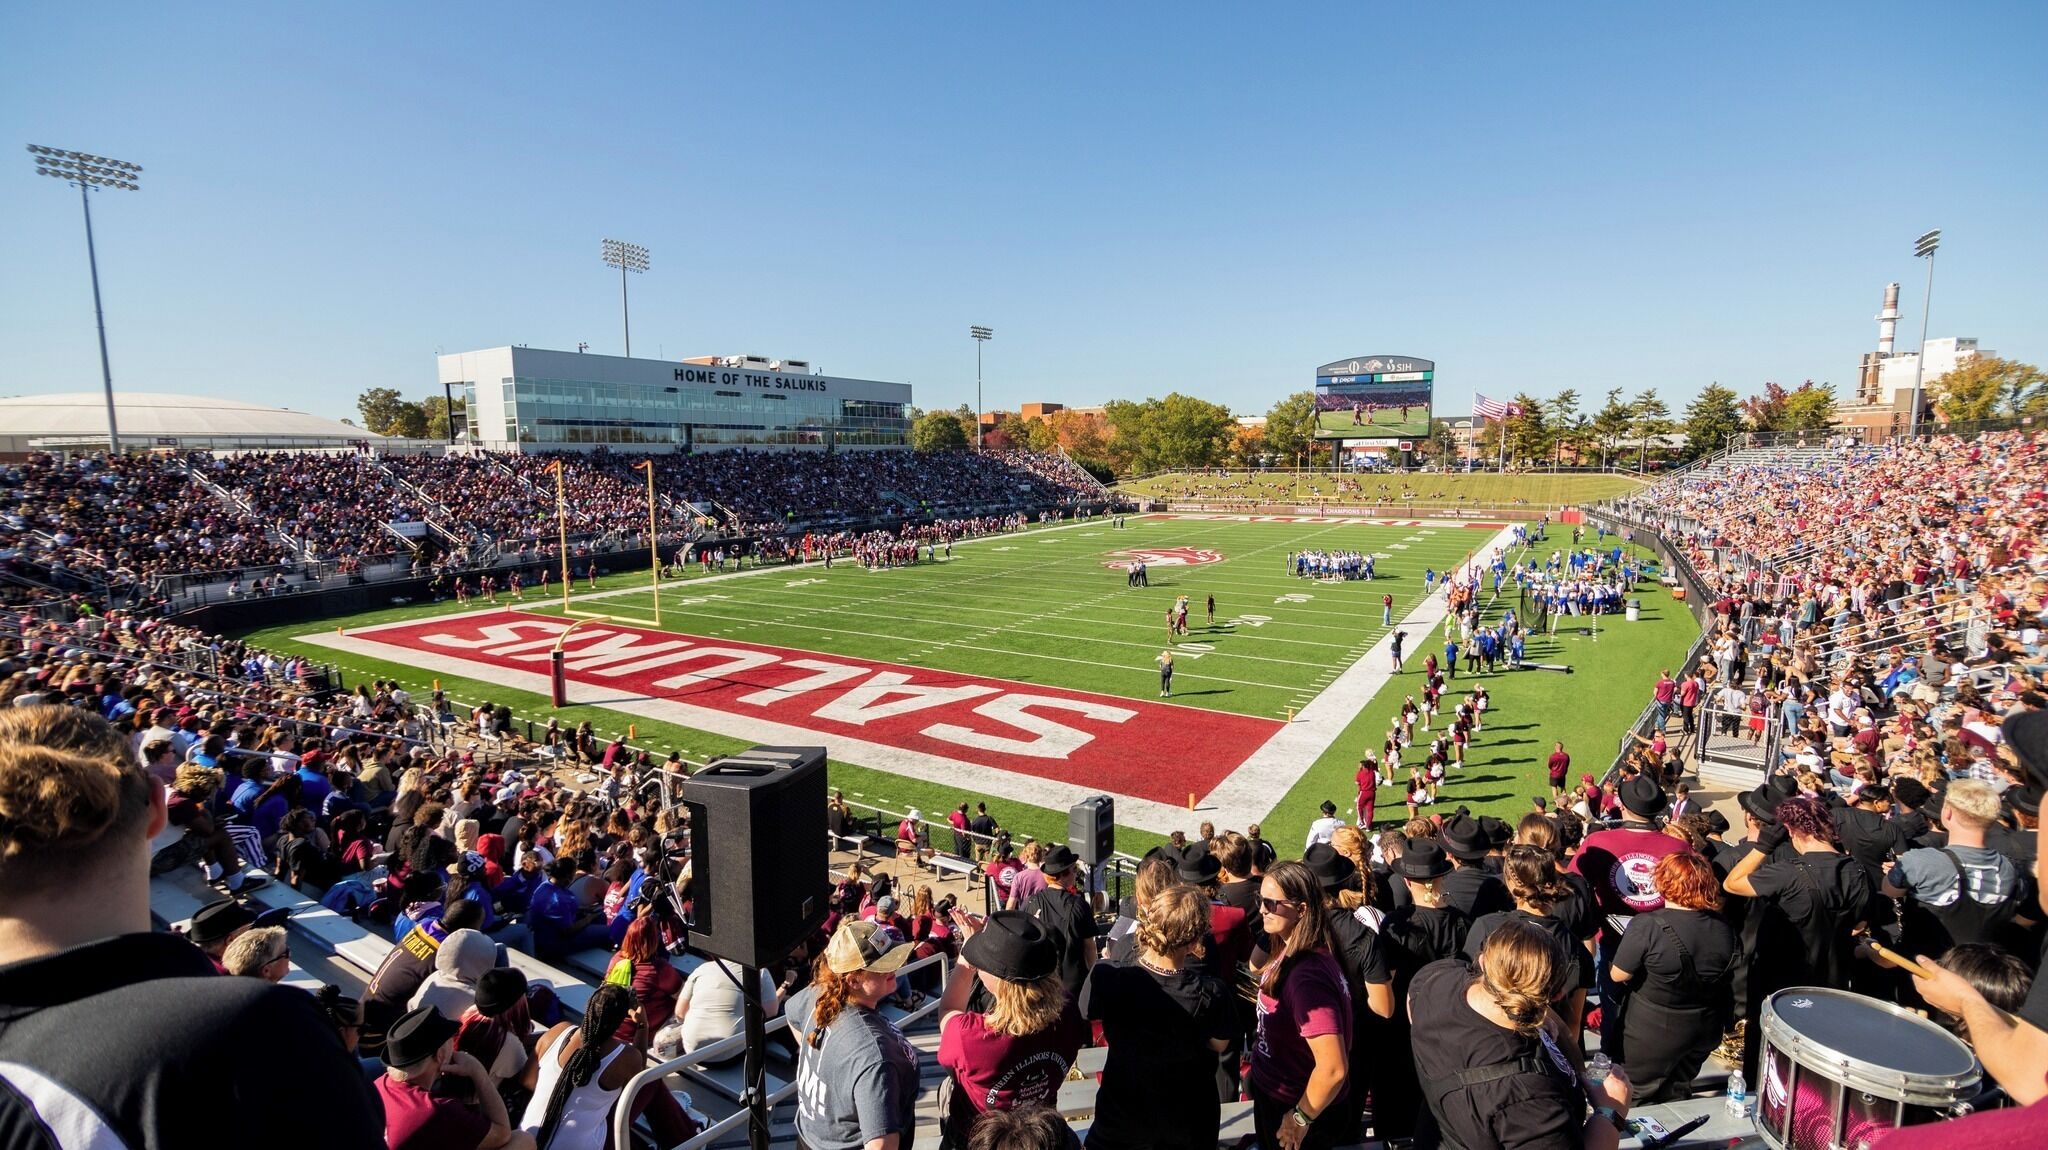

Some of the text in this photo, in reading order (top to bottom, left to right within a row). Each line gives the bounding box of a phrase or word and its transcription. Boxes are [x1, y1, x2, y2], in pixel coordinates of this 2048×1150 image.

[1396, 363, 1412, 371] SIH
[674, 368, 827, 391] HOME OF THE SALUKIS
[418, 620, 1139, 760] SALUKIS
[1015, 1051, 1050, 1072] ILLINOIS
